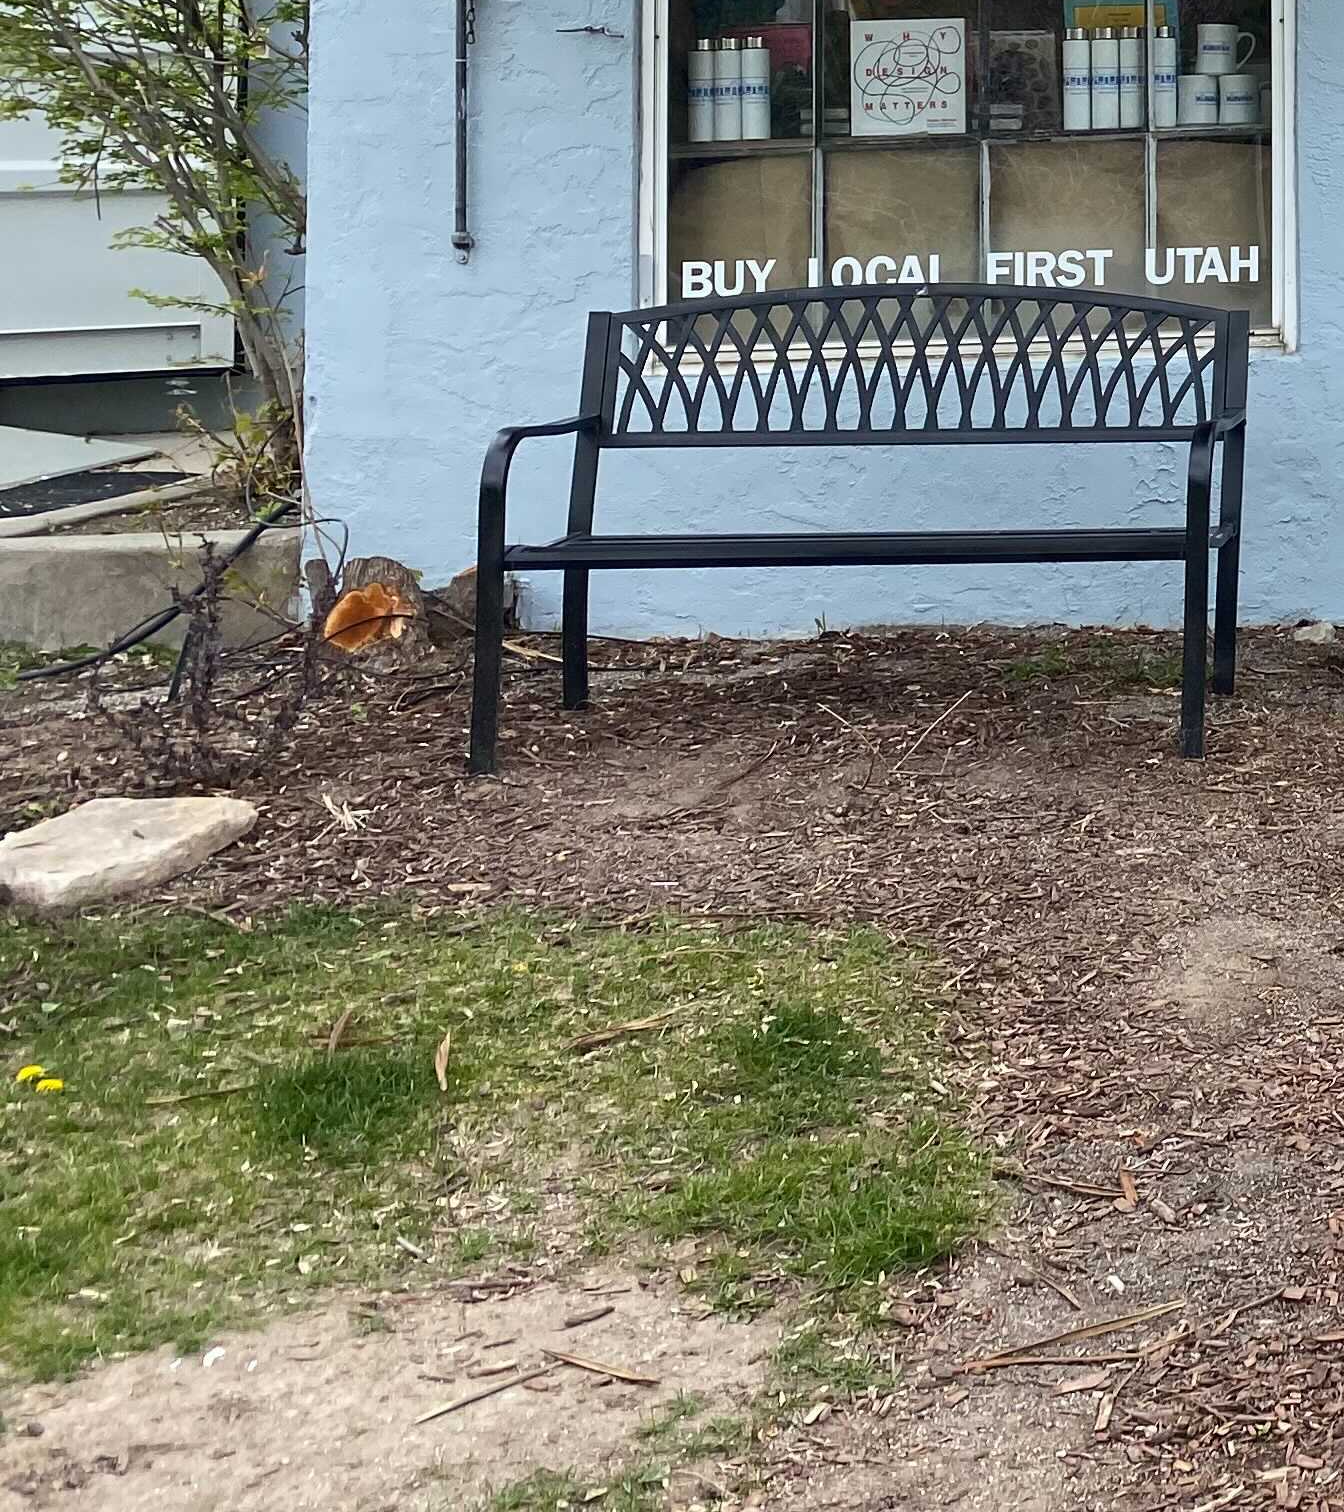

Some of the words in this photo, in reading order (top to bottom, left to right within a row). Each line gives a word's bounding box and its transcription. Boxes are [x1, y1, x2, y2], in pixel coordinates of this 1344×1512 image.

[681, 259, 776, 299] BUY
[986, 249, 1113, 287] FIRST
[1145, 245, 1260, 286] UTAH
